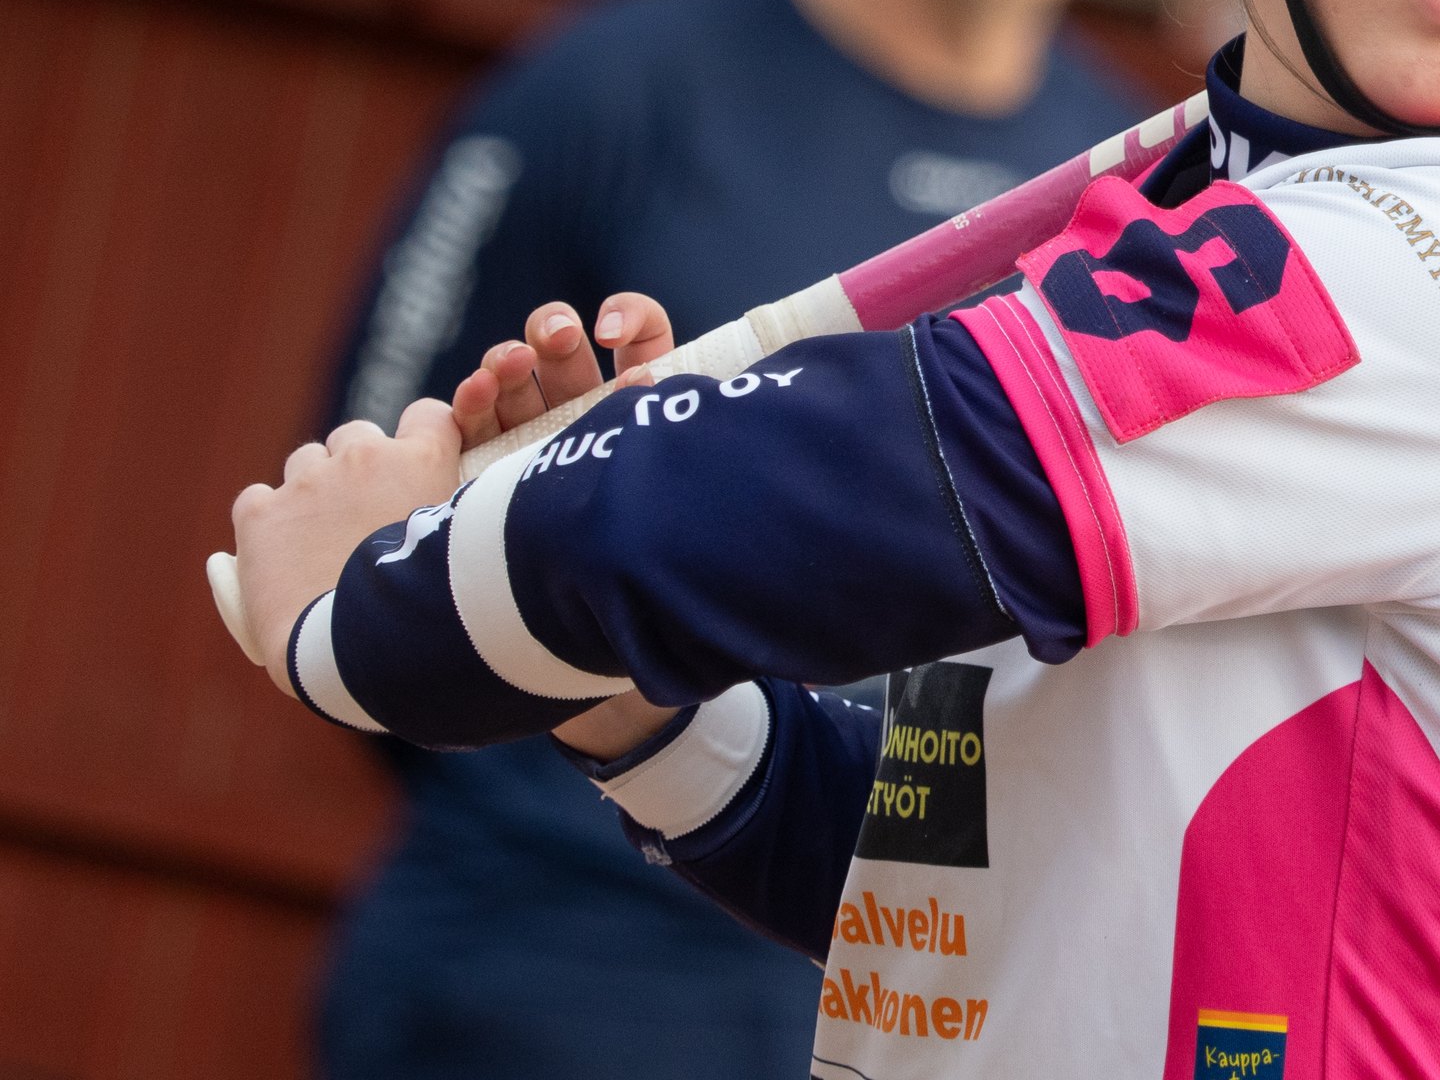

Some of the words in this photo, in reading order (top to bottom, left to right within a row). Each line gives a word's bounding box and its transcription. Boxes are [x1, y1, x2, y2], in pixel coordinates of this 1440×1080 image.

[718, 367, 804, 398] OY
[866, 775, 931, 820] TYÖT
[832, 891, 967, 957] alvelu
[818, 967, 989, 1041] akkonen
[1204, 1044, 1280, 1076] Kauppa-
